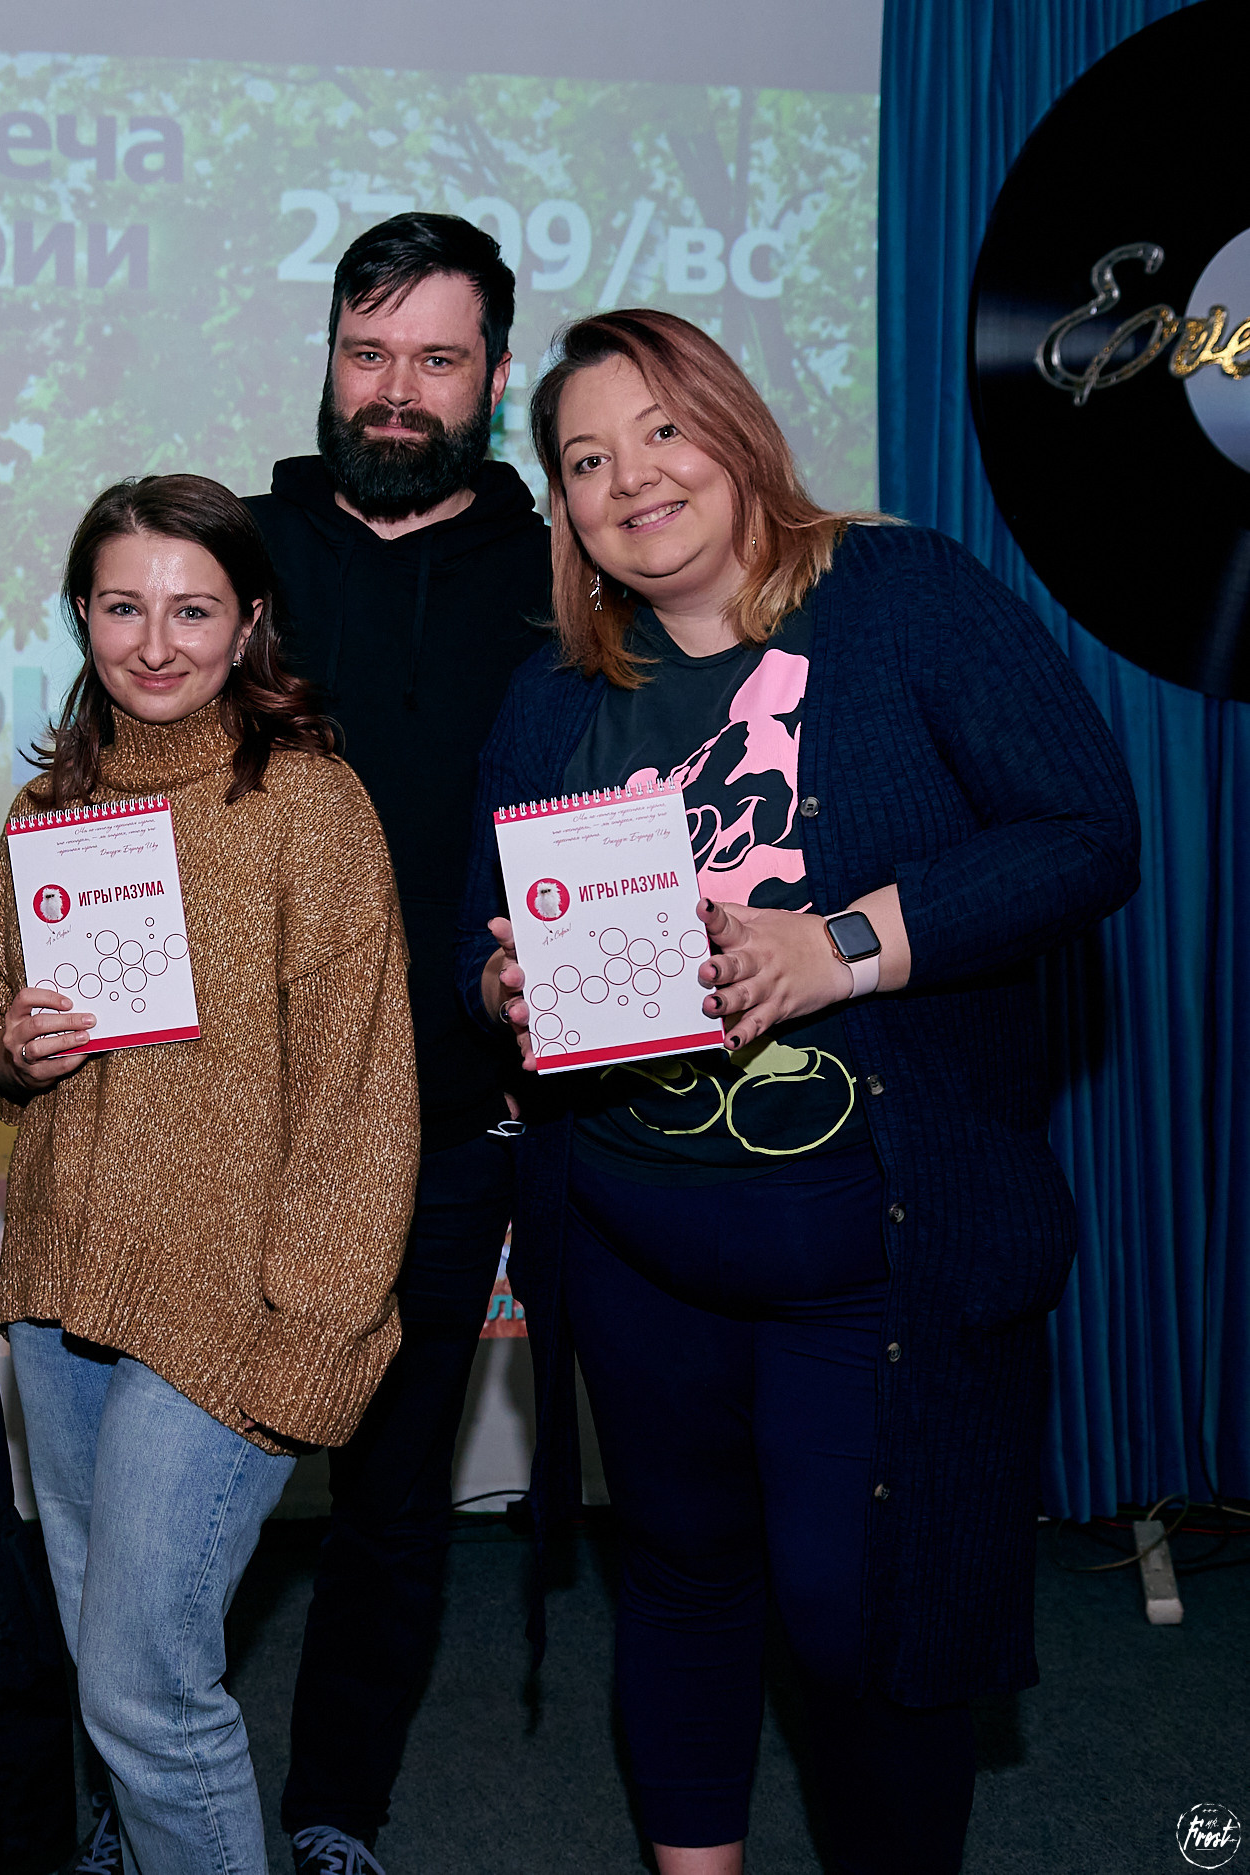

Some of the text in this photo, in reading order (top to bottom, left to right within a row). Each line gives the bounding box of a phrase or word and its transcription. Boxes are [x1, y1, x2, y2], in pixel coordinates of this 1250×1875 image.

[78, 880, 165, 907] ИГРЫ РАЗУМА
[578, 870, 680, 903] ИГРЫ РАЗУМА
